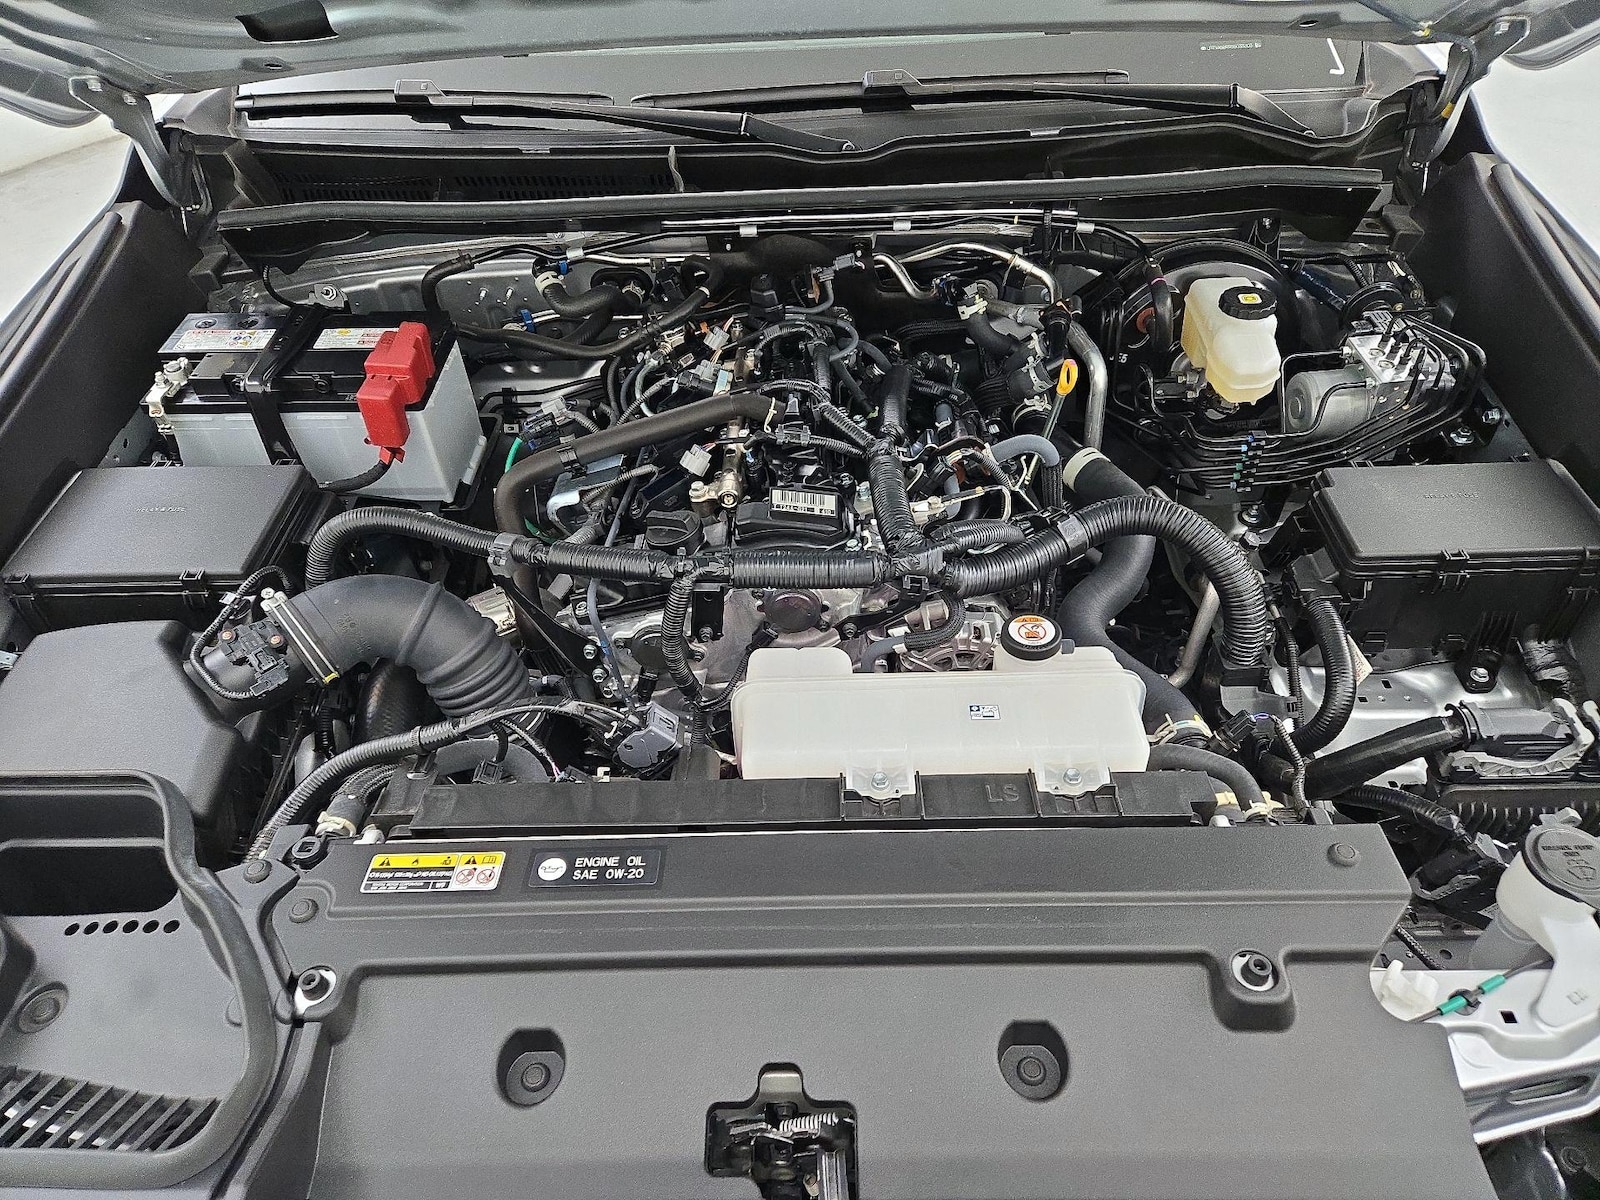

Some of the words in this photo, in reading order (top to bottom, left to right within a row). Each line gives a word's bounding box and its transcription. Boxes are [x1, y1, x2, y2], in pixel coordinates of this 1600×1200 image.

[985, 784, 1019, 803] LS
[574, 856, 620, 868] ENGINE
[626, 856, 646, 867] OIL
[572, 869, 599, 880] SAE
[605, 868, 645, 880] 0W-20
